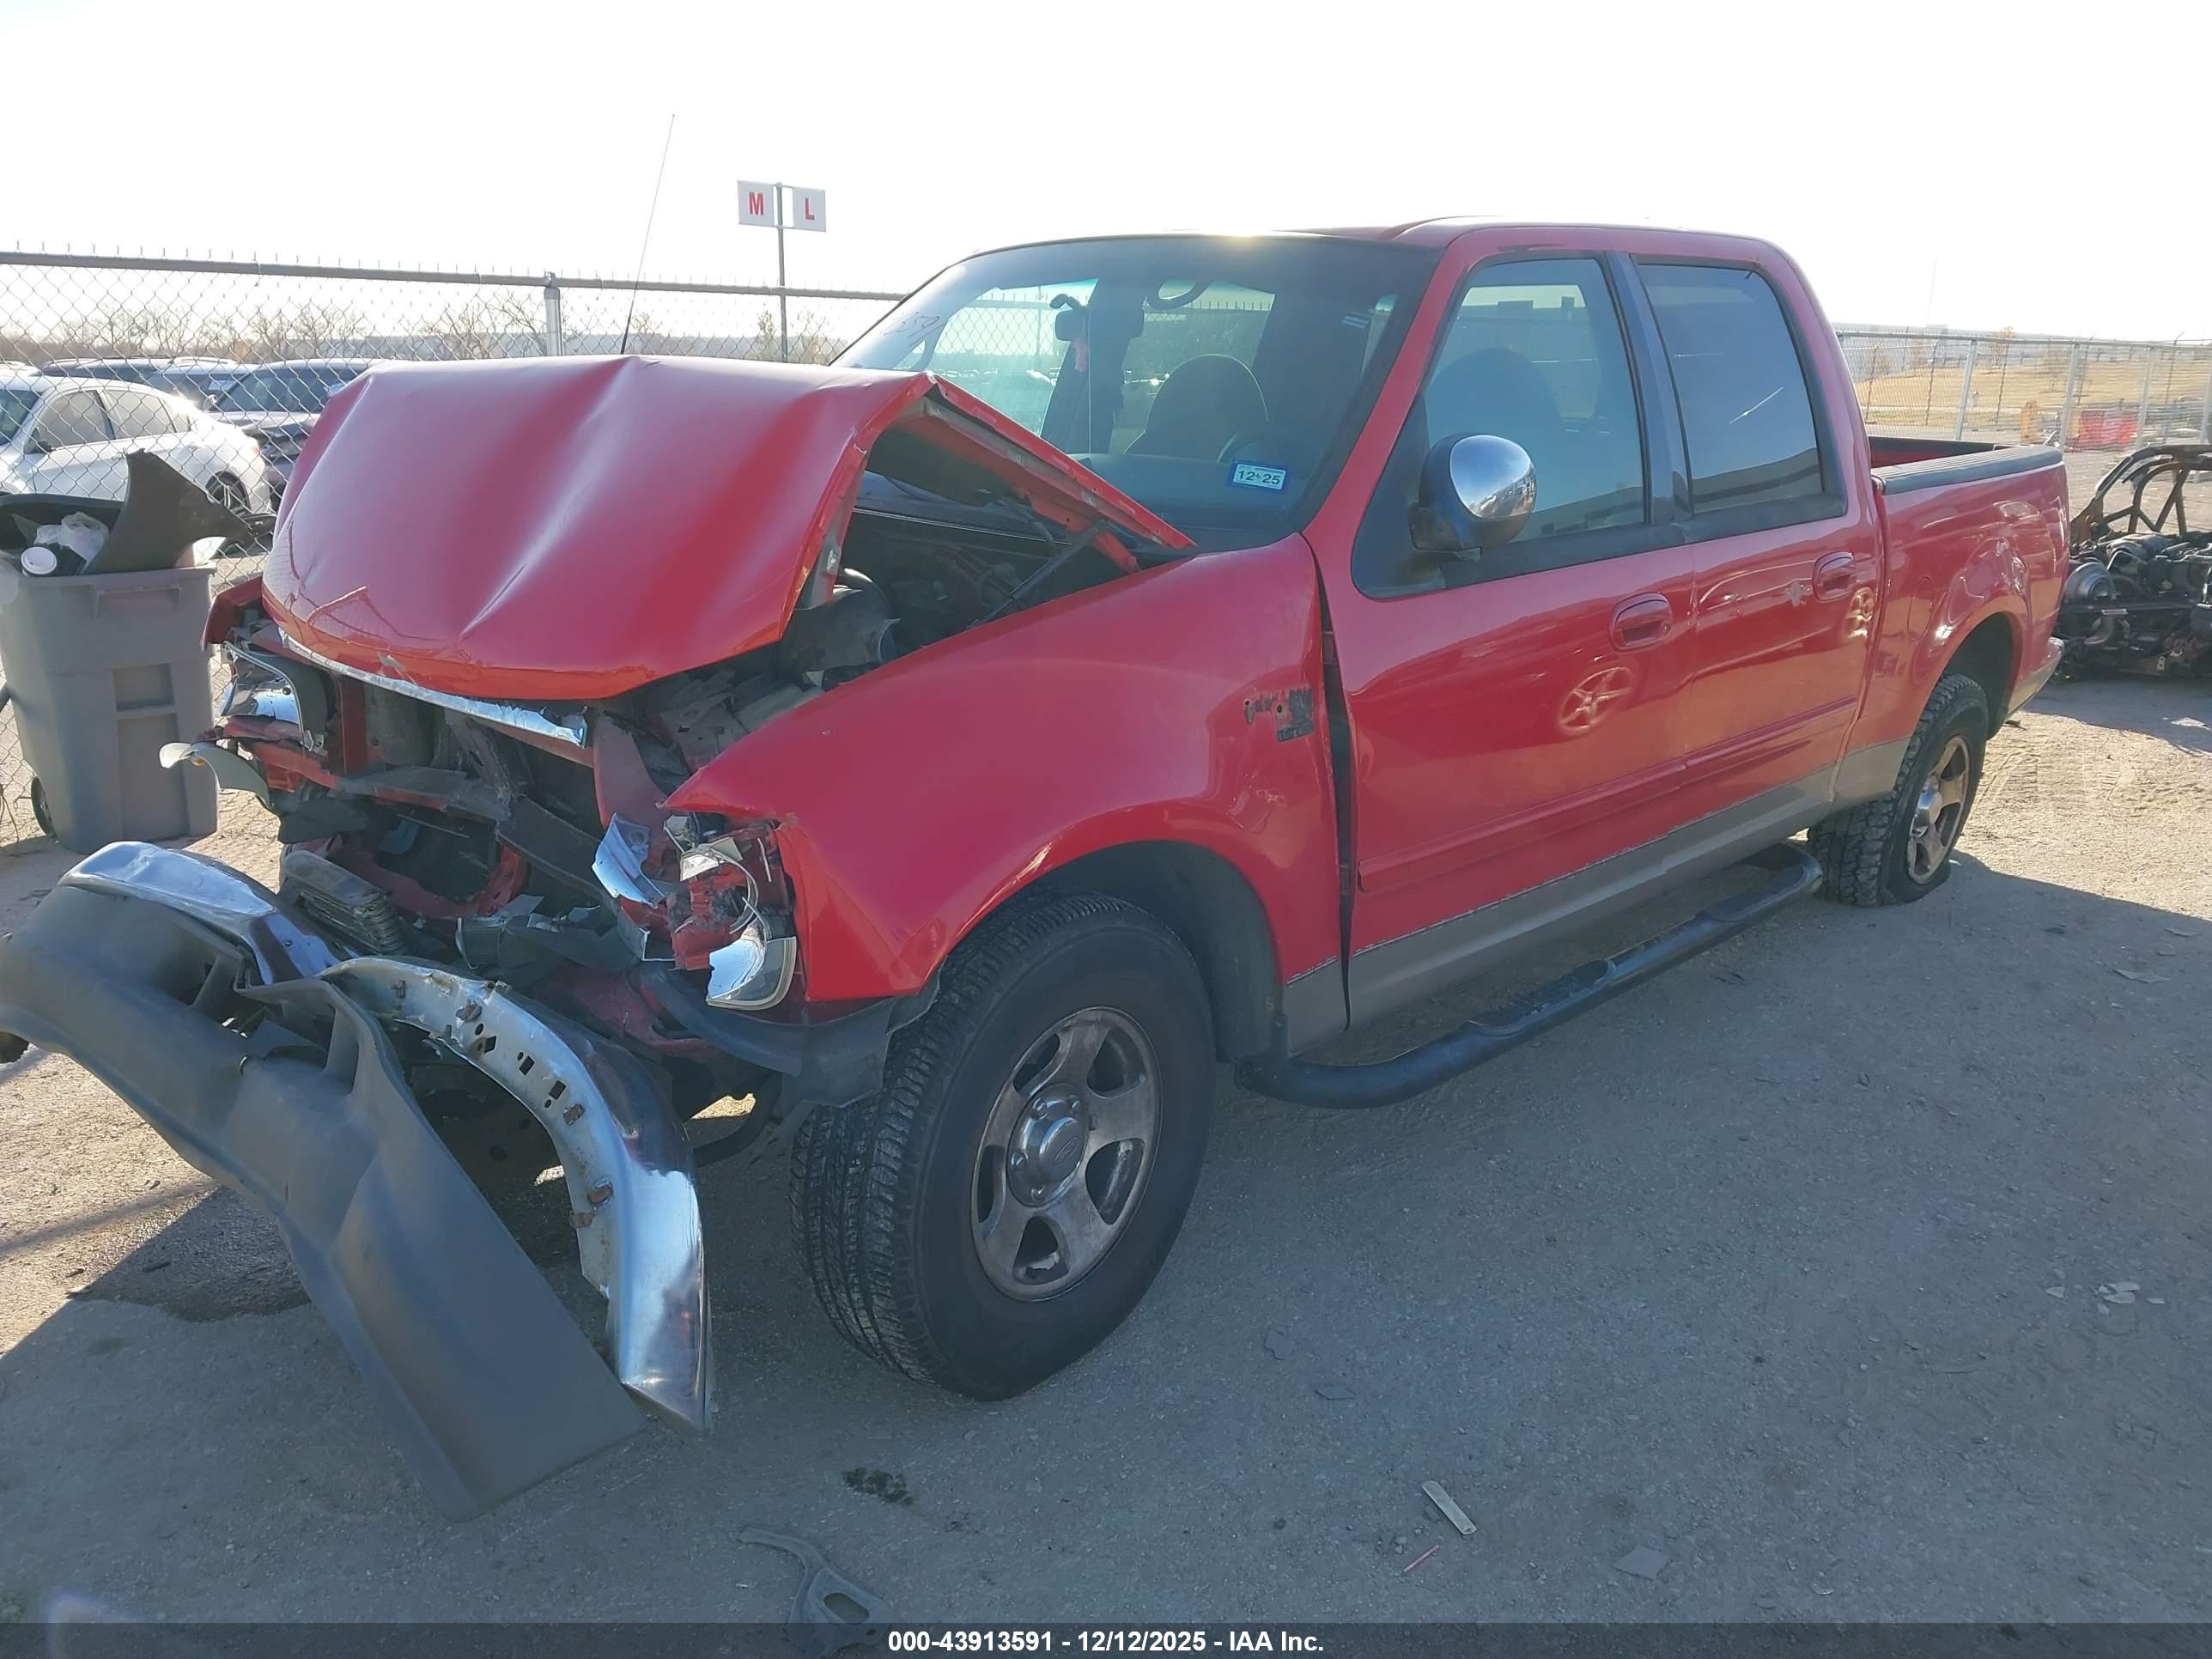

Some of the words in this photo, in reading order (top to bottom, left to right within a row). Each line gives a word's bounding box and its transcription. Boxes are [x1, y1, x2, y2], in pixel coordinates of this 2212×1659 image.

[749, 191, 764, 216] M
[804, 198, 815, 220] L
[1238, 470, 1255, 481] 12
[1262, 473, 1281, 485] 25
